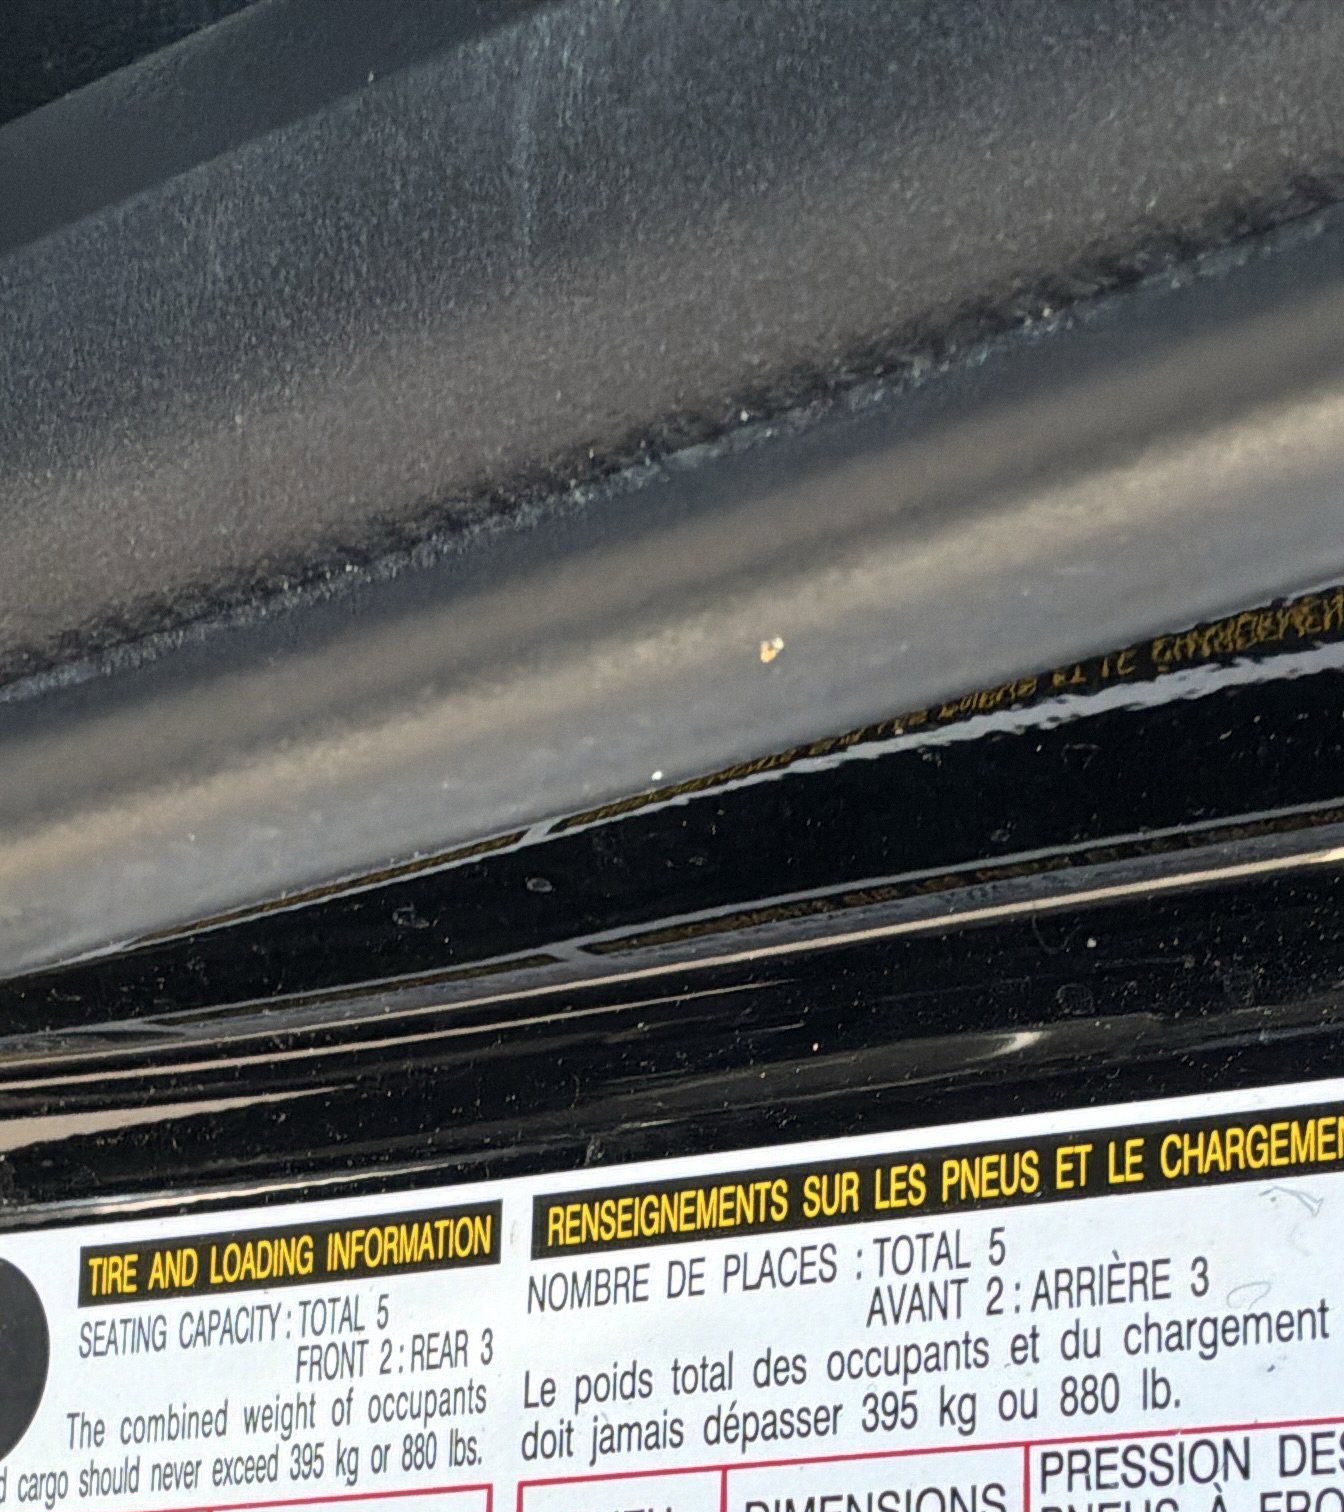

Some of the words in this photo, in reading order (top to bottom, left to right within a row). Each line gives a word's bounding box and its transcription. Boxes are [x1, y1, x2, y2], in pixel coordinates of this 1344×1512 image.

[547, 1178, 789, 1247] RENSEIGNEMENTS
[802, 1171, 860, 1218] SUR
[874, 1162, 927, 1210] LES
[941, 1149, 1041, 1203] PNEUS
[1055, 1143, 1093, 1190] ET
[1108, 1138, 1145, 1184] LE
[88, 1253, 139, 1297] TIRE
[147, 1247, 199, 1291] AND
[209, 1234, 314, 1284] LOADING
[326, 1214, 492, 1272] INFORMATION
[527, 1263, 650, 1314] NOMBRE
[667, 1257, 706, 1299] DE
[723, 1242, 837, 1293] PLACES
[79, 1314, 167, 1359] SEATING
[866, 1277, 969, 1328] AVANT
[296, 1339, 369, 1382] FRONT
[524, 1370, 556, 1409] Le
[574, 1360, 653, 1415] poids
[671, 1350, 734, 1396] total
[753, 1347, 807, 1389] des
[826, 1331, 990, 1386] occupants
[1010, 1324, 1040, 1366] et
[1060, 1318, 1101, 1361] du
[1123, 1298, 1330, 1361] chargement
[66, 1412, 105, 1449] The
[120, 1400, 228, 1445] combined
[244, 1394, 316, 1441] weight
[331, 1387, 354, 1427] of
[368, 1379, 487, 1428] occupants
[521, 1418, 575, 1461] doit
[589, 1409, 684, 1467] jamais
[703, 1400, 843, 1454] dépasser
[861, 1389, 918, 1433] 395
[939, 1385, 977, 1437] kg
[998, 1387, 1038, 1422] ou
[1060, 1372, 1120, 1417] 880
[1142, 1367, 1180, 1411] lb.
[18, 1471, 69, 1510] cargo
[78, 1457, 140, 1498] should
[151, 1460, 202, 1491] never
[212, 1444, 279, 1487] exceed
[289, 1442, 324, 1481] 395
[335, 1439, 359, 1487] kg
[371, 1444, 391, 1474] or
[401, 1431, 437, 1472] 880
[448, 1428, 482, 1467] lbs.
[1040, 1436, 1251, 1495] PRESSION
